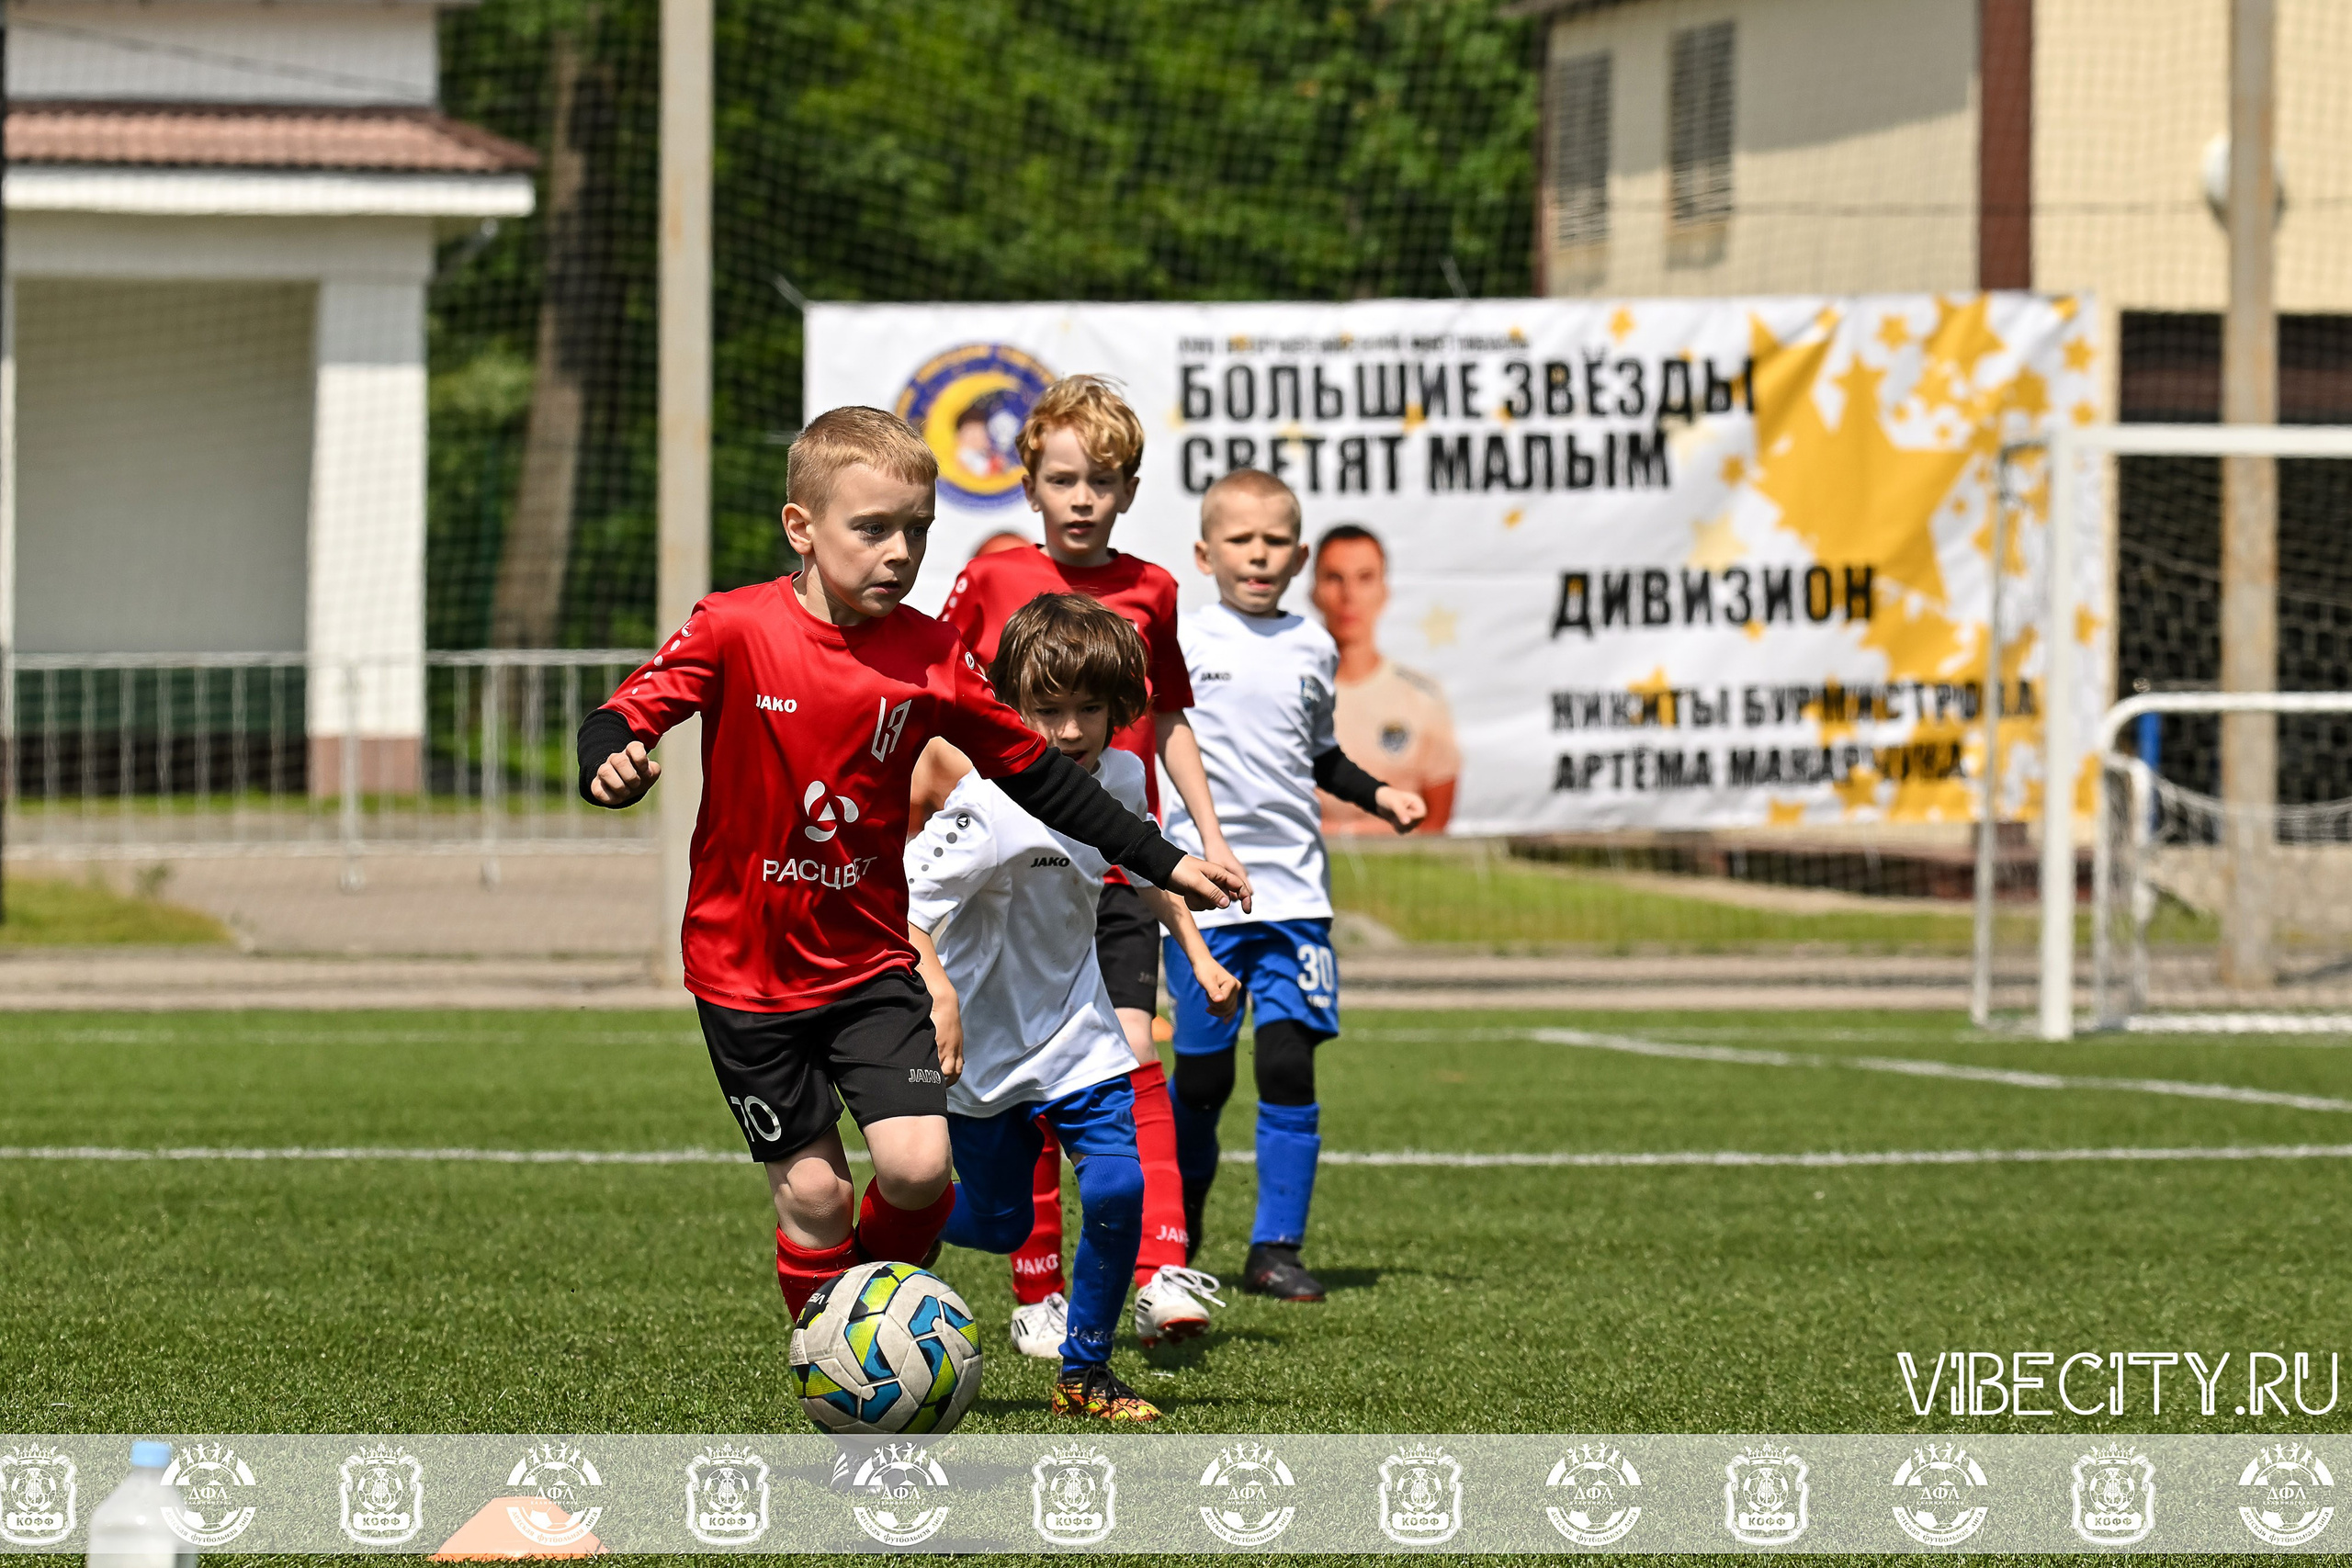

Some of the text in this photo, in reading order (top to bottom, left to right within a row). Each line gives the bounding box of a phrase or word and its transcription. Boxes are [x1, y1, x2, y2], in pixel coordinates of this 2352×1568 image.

[1180, 347, 1757, 422] БОЛЬШИЕ ЗВЁЗДЫ
[1427, 429, 1670, 491] МАЛЫМ
[1551, 566, 1875, 639] ДИВИЗИОН
[756, 694, 797, 713] JAKO
[1743, 680, 2038, 725] БУРМИСТРОА
[1030, 857, 1071, 868] JAKO
[1297, 943, 1335, 992] 30
[908, 1068, 942, 1085] JAKO
[1014, 1253, 1059, 1275] JAKO
